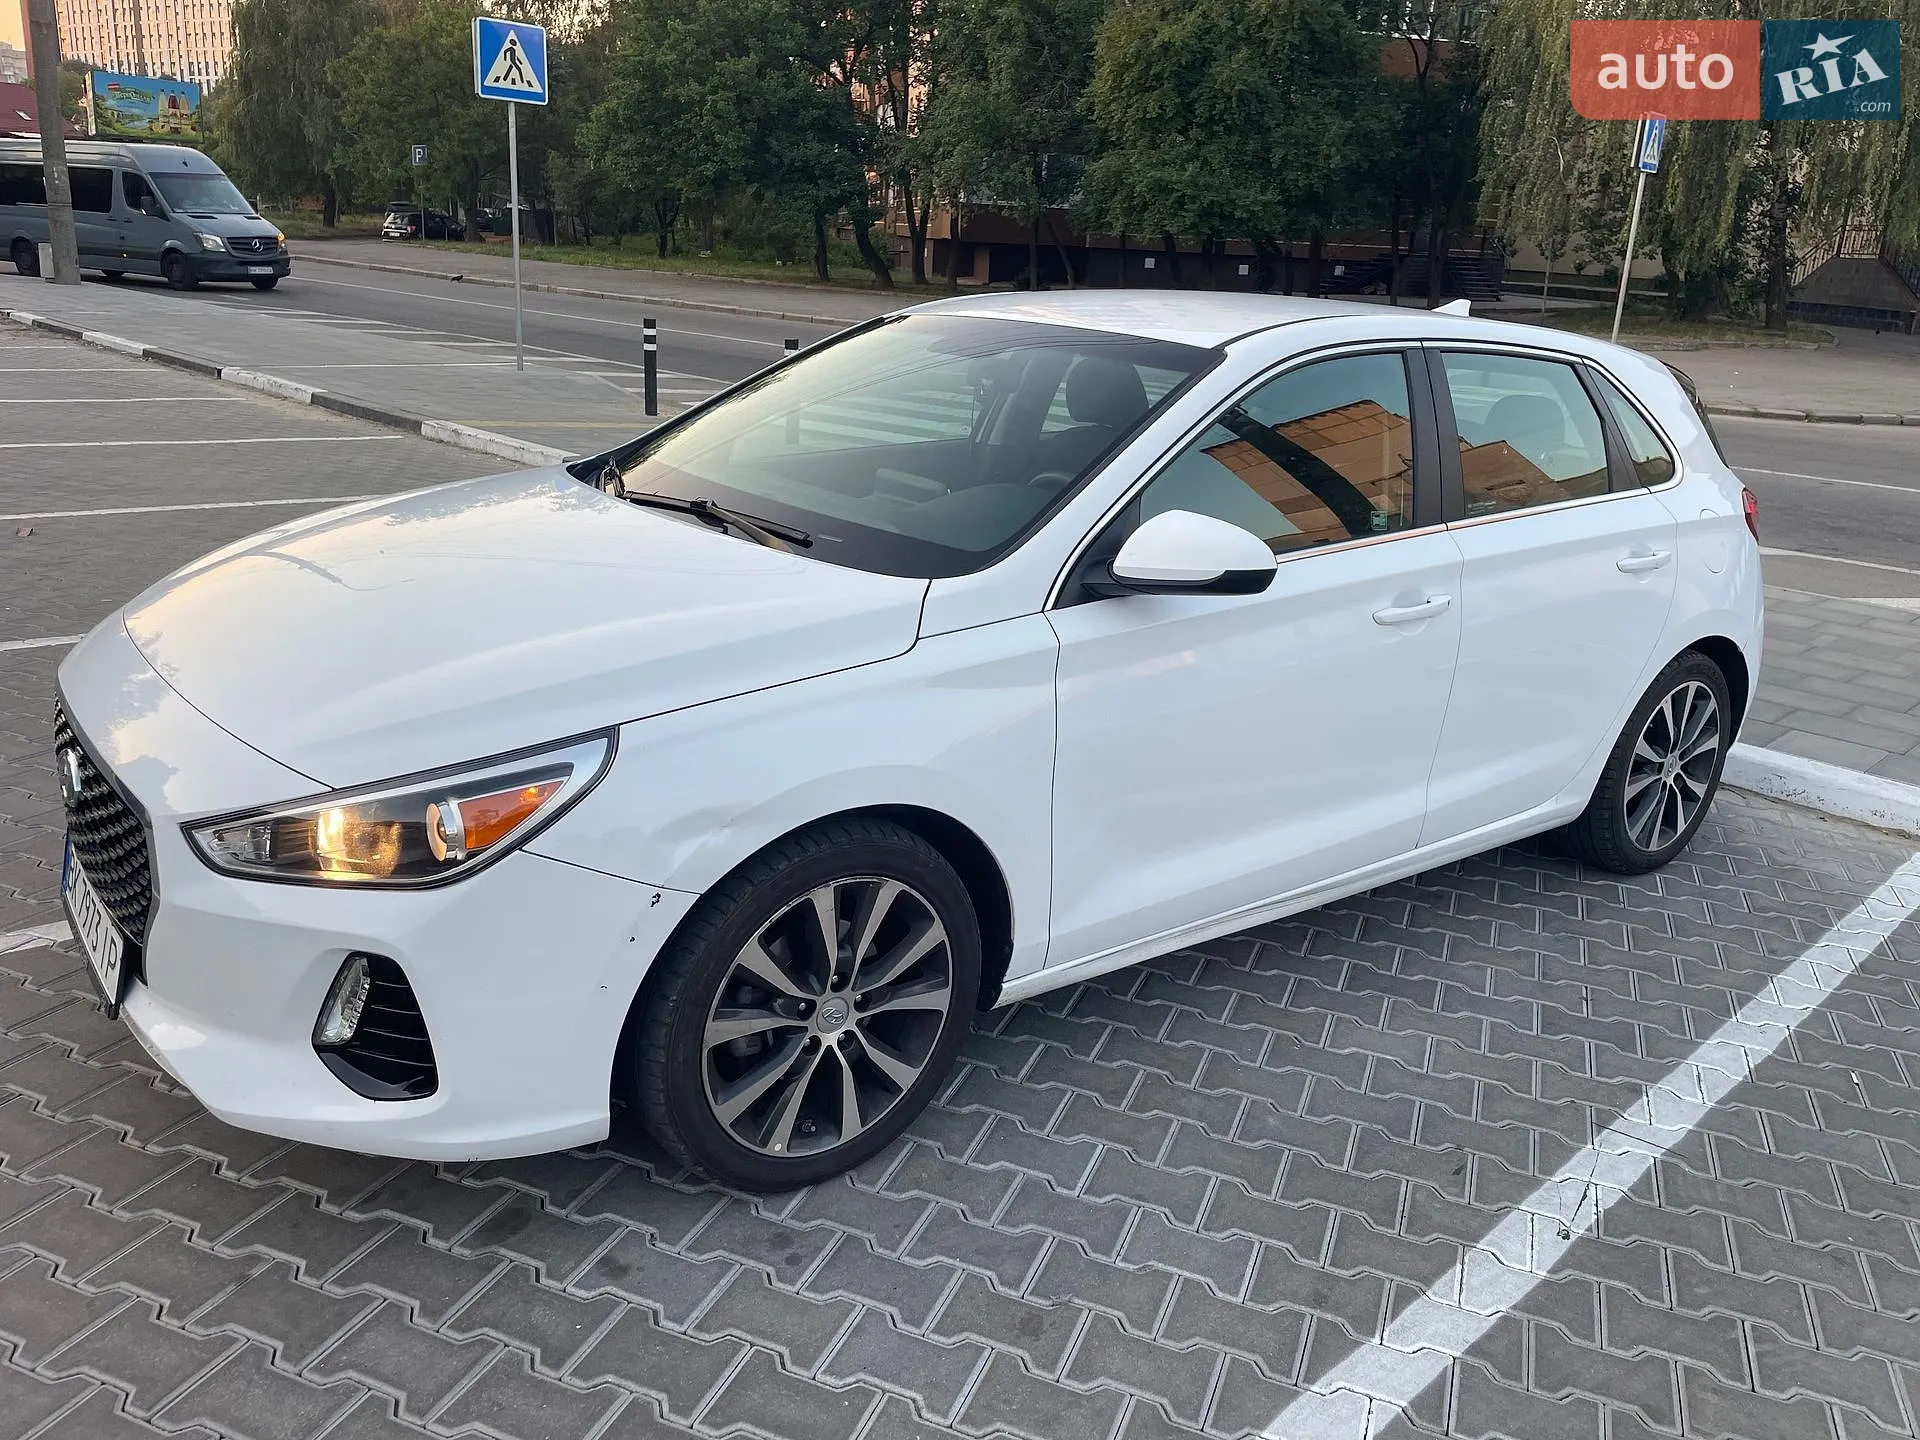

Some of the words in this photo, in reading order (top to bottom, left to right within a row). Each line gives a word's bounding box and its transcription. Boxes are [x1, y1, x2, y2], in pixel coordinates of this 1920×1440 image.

[415, 148, 423, 163] P
[79, 877, 102, 953] 7973
[100, 926, 118, 979] IP
